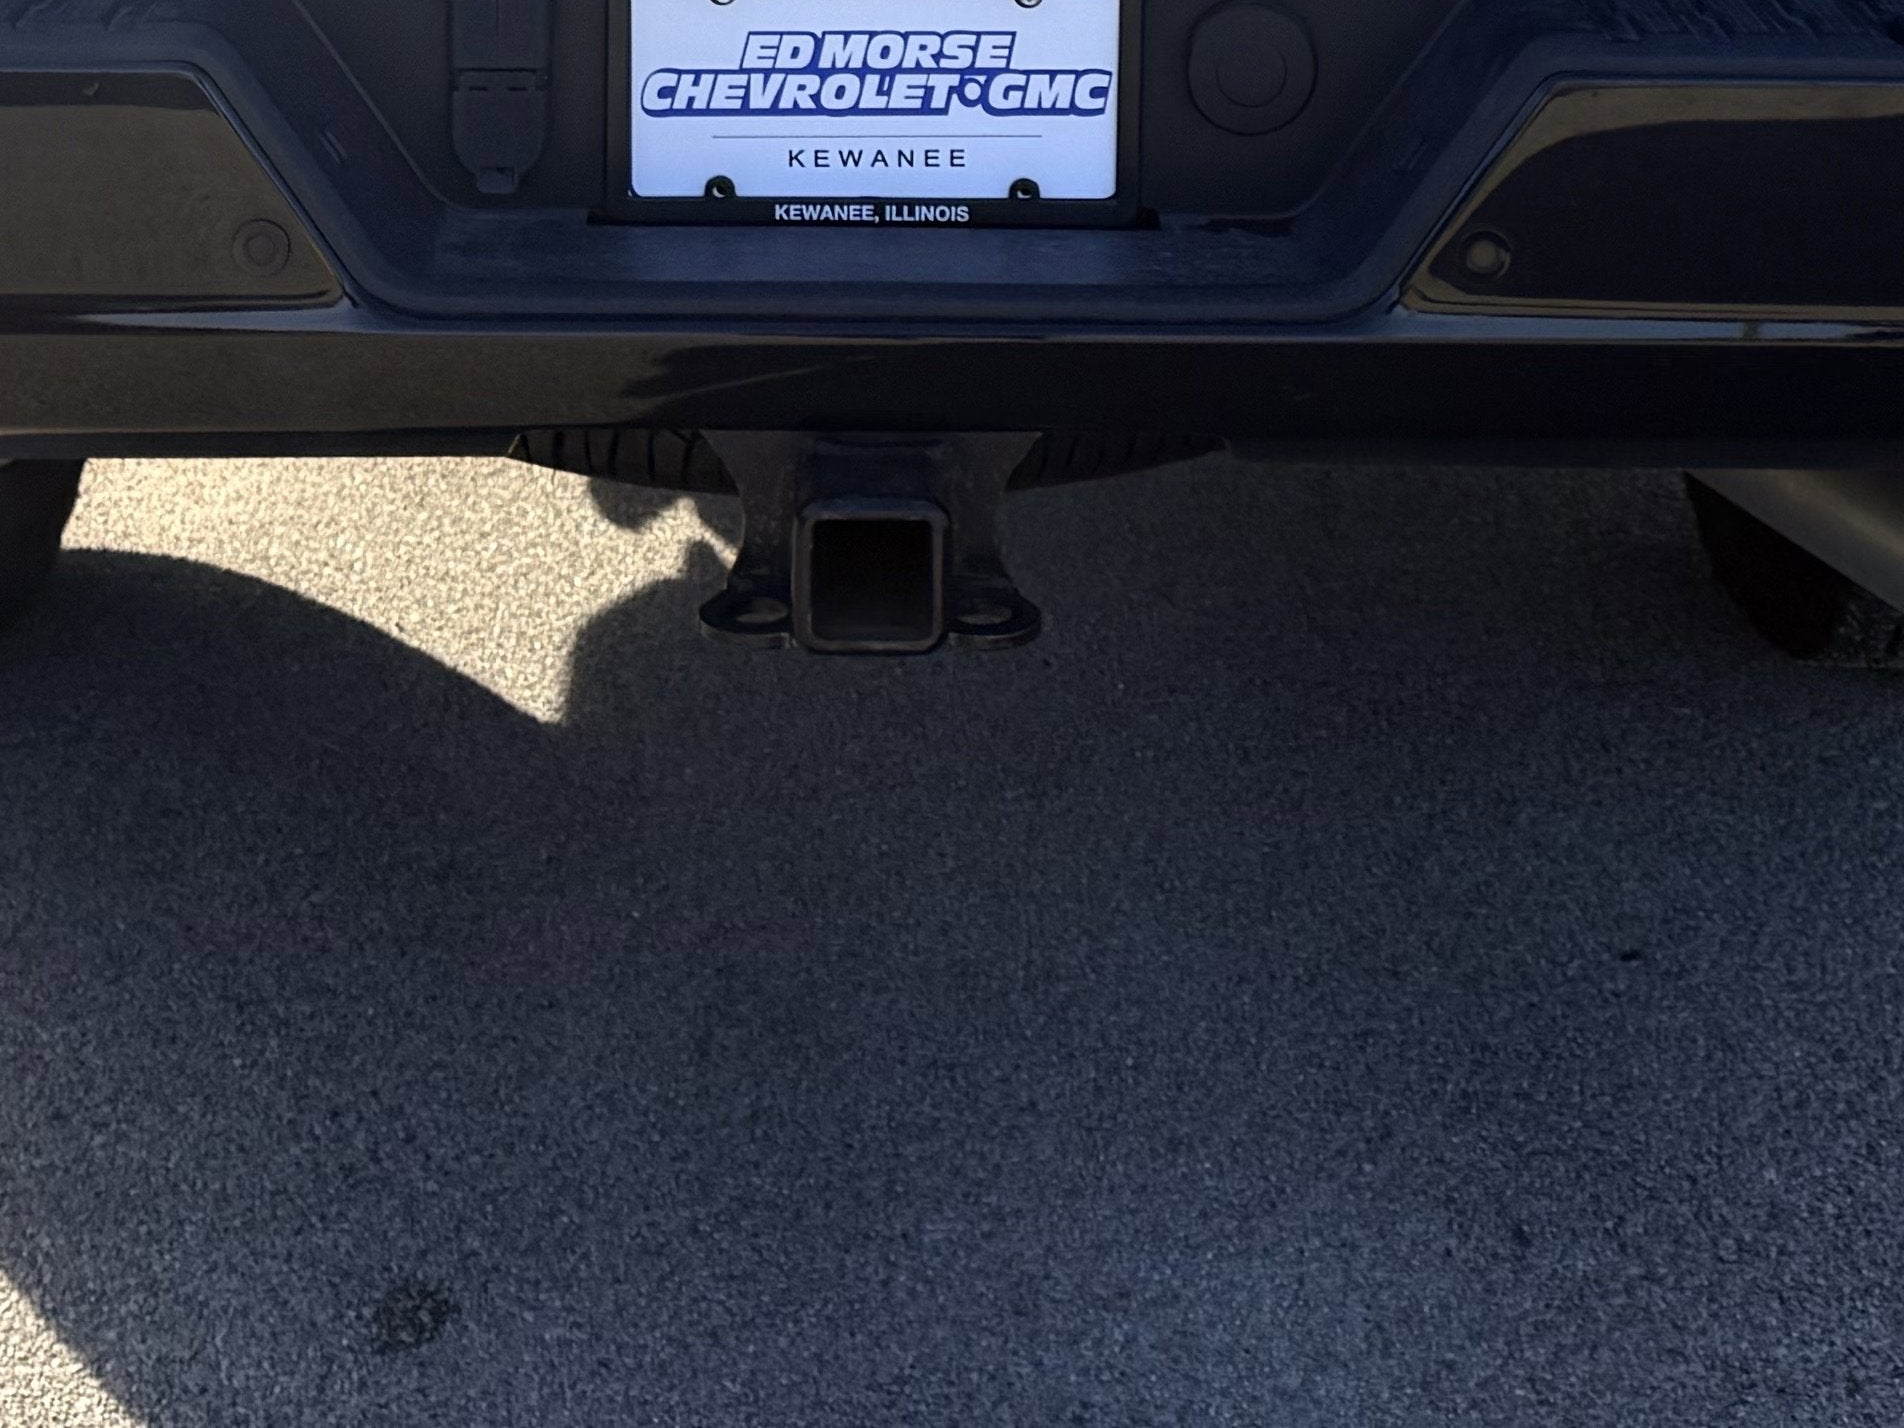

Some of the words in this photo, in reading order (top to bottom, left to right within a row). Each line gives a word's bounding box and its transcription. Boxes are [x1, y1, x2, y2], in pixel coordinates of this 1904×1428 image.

[741, 32, 817, 70] ED
[817, 32, 1015, 70] MORSE
[788, 149, 966, 168] KEWANEE
[774, 204, 880, 224] KEWANEE,
[885, 206, 970, 223] ILLINOIS
